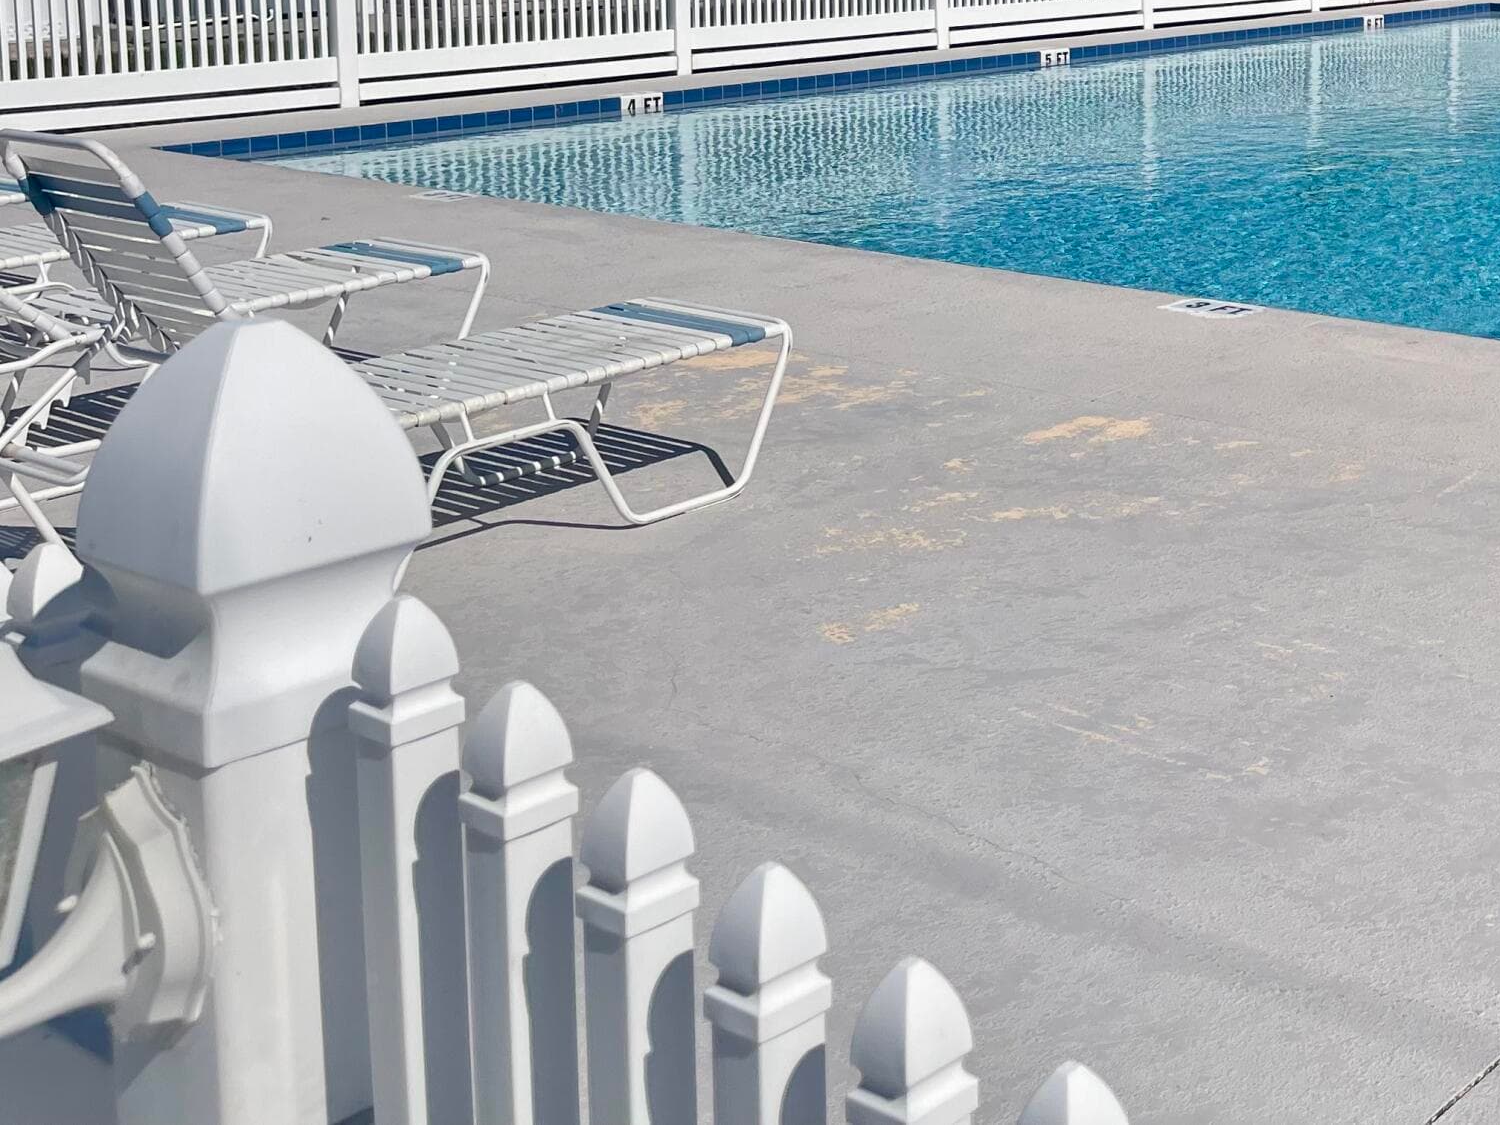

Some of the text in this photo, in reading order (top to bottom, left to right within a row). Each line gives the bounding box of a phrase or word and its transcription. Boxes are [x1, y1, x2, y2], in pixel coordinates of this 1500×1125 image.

[1045, 51, 1069, 66] 5 FT
[643, 96, 662, 111] FT
